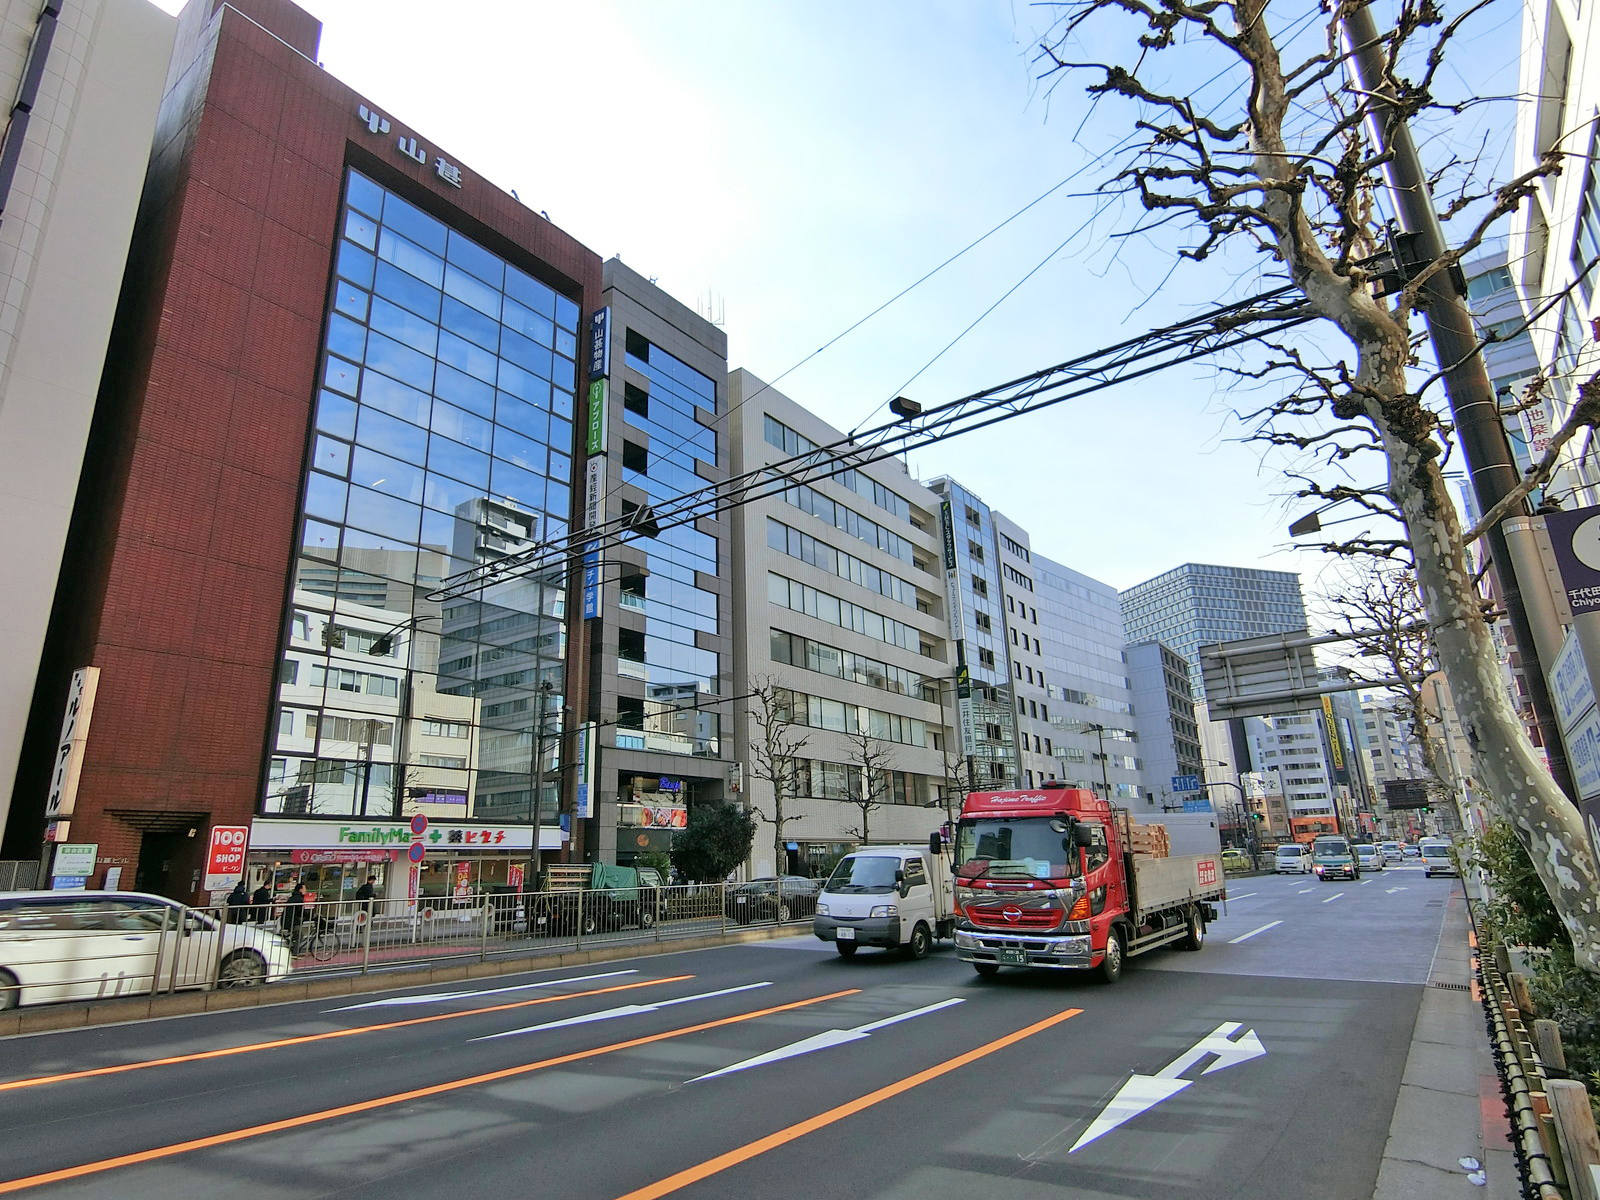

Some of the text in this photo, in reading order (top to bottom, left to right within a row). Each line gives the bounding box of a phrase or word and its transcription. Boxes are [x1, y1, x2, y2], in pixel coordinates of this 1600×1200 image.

[593, 328, 604, 372] 山甚物産
[961, 701, 973, 752] 三井住友銀行
[1020, 794, 1047, 803] Traffic
[214, 831, 245, 846] 100
[339, 826, 414, 845] FamilyMa
[215, 854, 241, 863] SHOP
